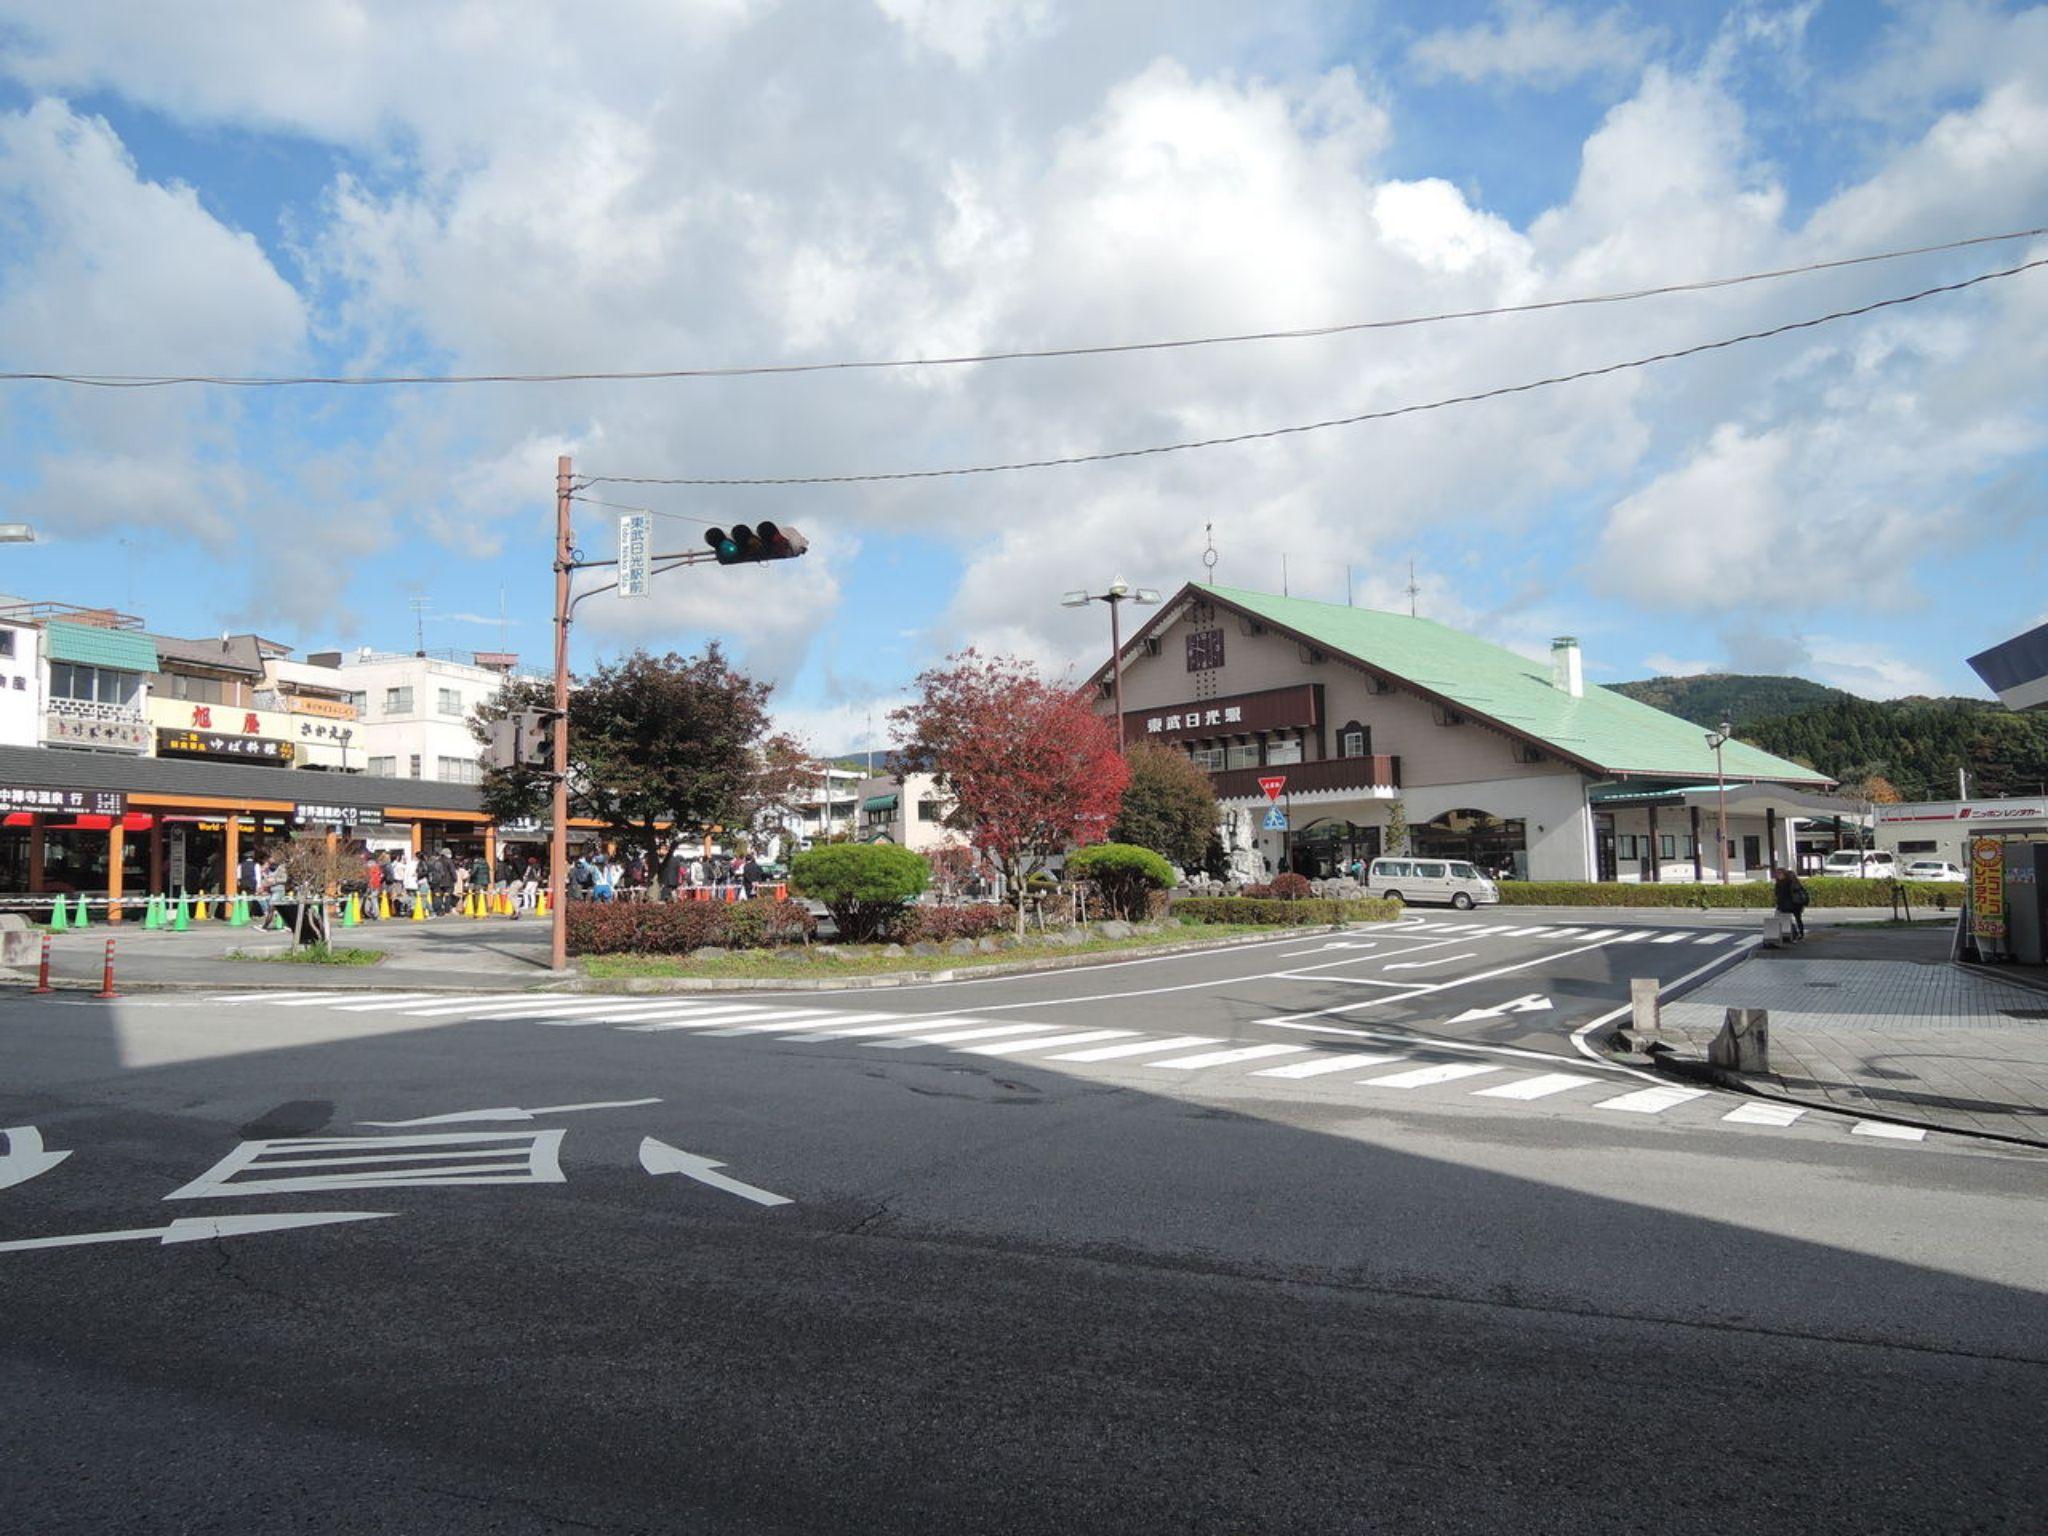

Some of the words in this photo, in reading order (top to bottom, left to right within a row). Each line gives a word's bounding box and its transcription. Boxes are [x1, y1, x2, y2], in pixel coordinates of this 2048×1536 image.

[621, 521, 630, 544] Tobu
[621, 545, 630, 570] Nikko
[631, 516, 644, 594] 東武日光駅前
[191, 704, 261, 735] 旭屋
[1147, 706, 1241, 733] 東武日光駅
[210, 738, 277, 755] ゆば料理
[1972, 809, 2042, 818] ニッポンレンタカー
[1974, 866, 1987, 912] レンタカー
[1988, 867, 2001, 914] ニコニコ
